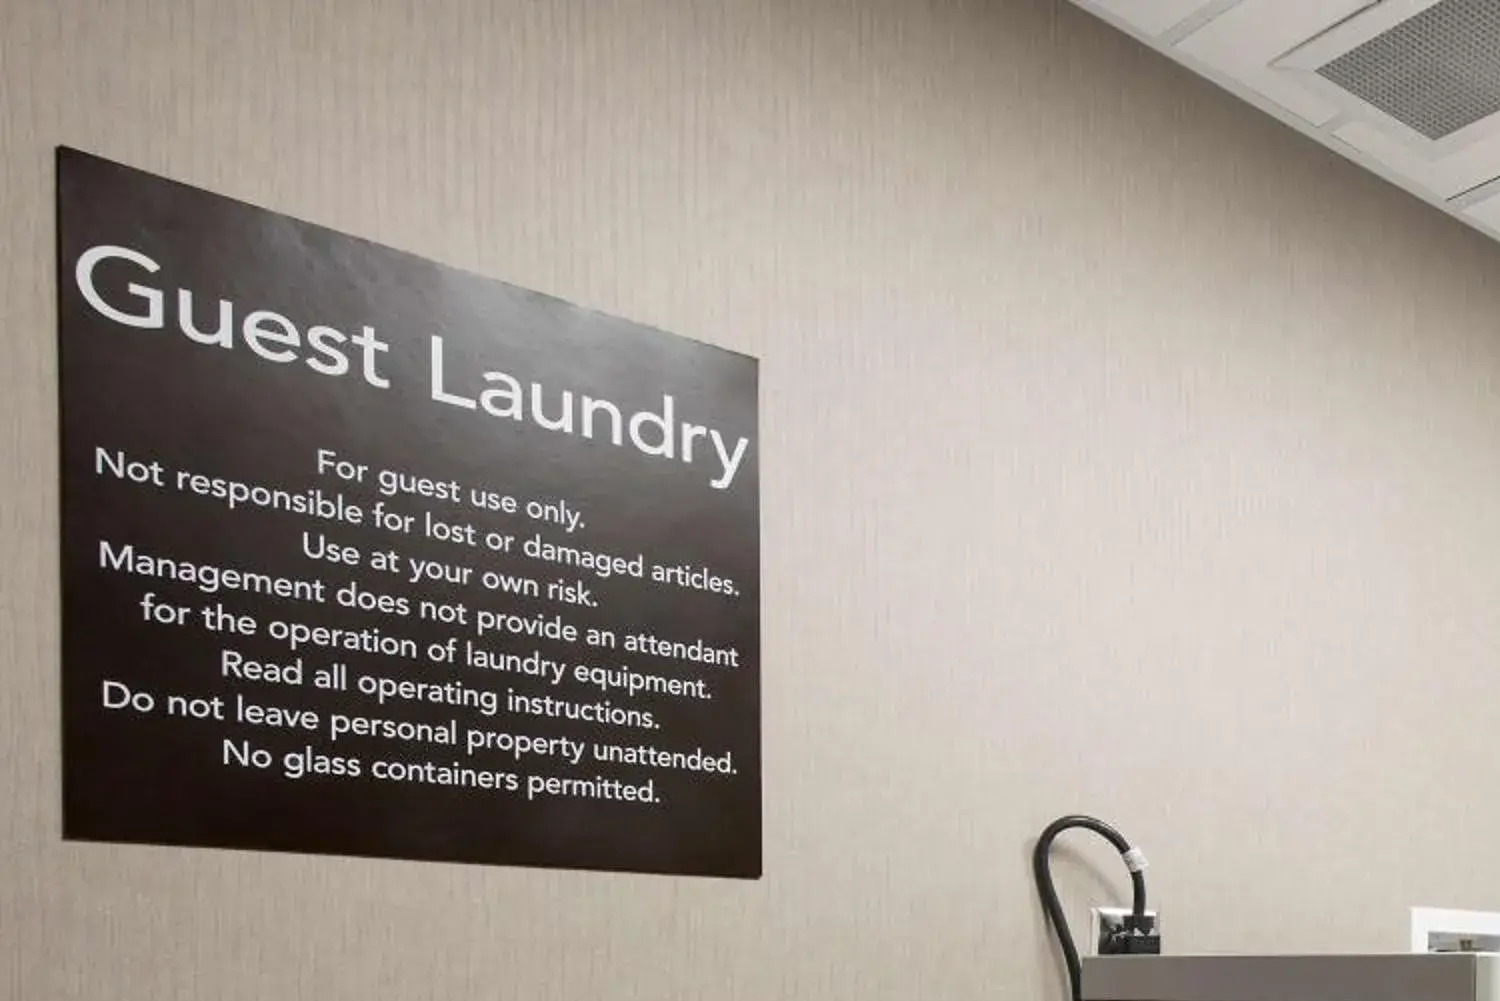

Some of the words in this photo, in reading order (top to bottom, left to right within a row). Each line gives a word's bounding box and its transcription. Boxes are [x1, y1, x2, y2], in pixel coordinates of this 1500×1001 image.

[74, 245, 390, 390] Guest
[430, 334, 750, 490] Laundry
[95, 447, 165, 487] Not
[176, 471, 364, 524] responsible
[372, 502, 416, 533] for
[425, 512, 477, 546] lost
[486, 533, 515, 553] or
[524, 534, 644, 578] damaged
[652, 564, 741, 597] articles.
[317, 449, 369, 482] For
[378, 470, 461, 502] guest
[471, 488, 518, 514] use
[526, 502, 586, 533] only.
[100, 540, 327, 604] Management
[336, 581, 411, 617] does
[420, 601, 469, 625] not
[477, 610, 578, 642] provide
[586, 629, 616, 650] an
[624, 633, 740, 667] attendant
[302, 532, 362, 565] Use
[370, 550, 400, 574] at
[409, 558, 474, 584] your
[482, 572, 539, 597] own
[547, 578, 599, 607] risk.
[139, 592, 192, 626] for
[201, 603, 258, 636] the
[268, 621, 418, 659] operation
[427, 638, 458, 663] of
[467, 640, 567, 685] laundry
[574, 665, 713, 700] equipment.
[221, 650, 304, 686] Read
[314, 663, 348, 691] all
[358, 675, 498, 717] operating
[507, 687, 661, 730] instructions.
[102, 680, 156, 713] Do
[167, 696, 225, 720] not
[237, 694, 321, 731] leave
[331, 714, 458, 745] personal
[467, 728, 586, 765] property
[594, 744, 739, 775] unattended.
[222, 739, 273, 769] No
[283, 745, 362, 779] glass
[371, 757, 519, 791] containers
[527, 775, 662, 803] permitted.
